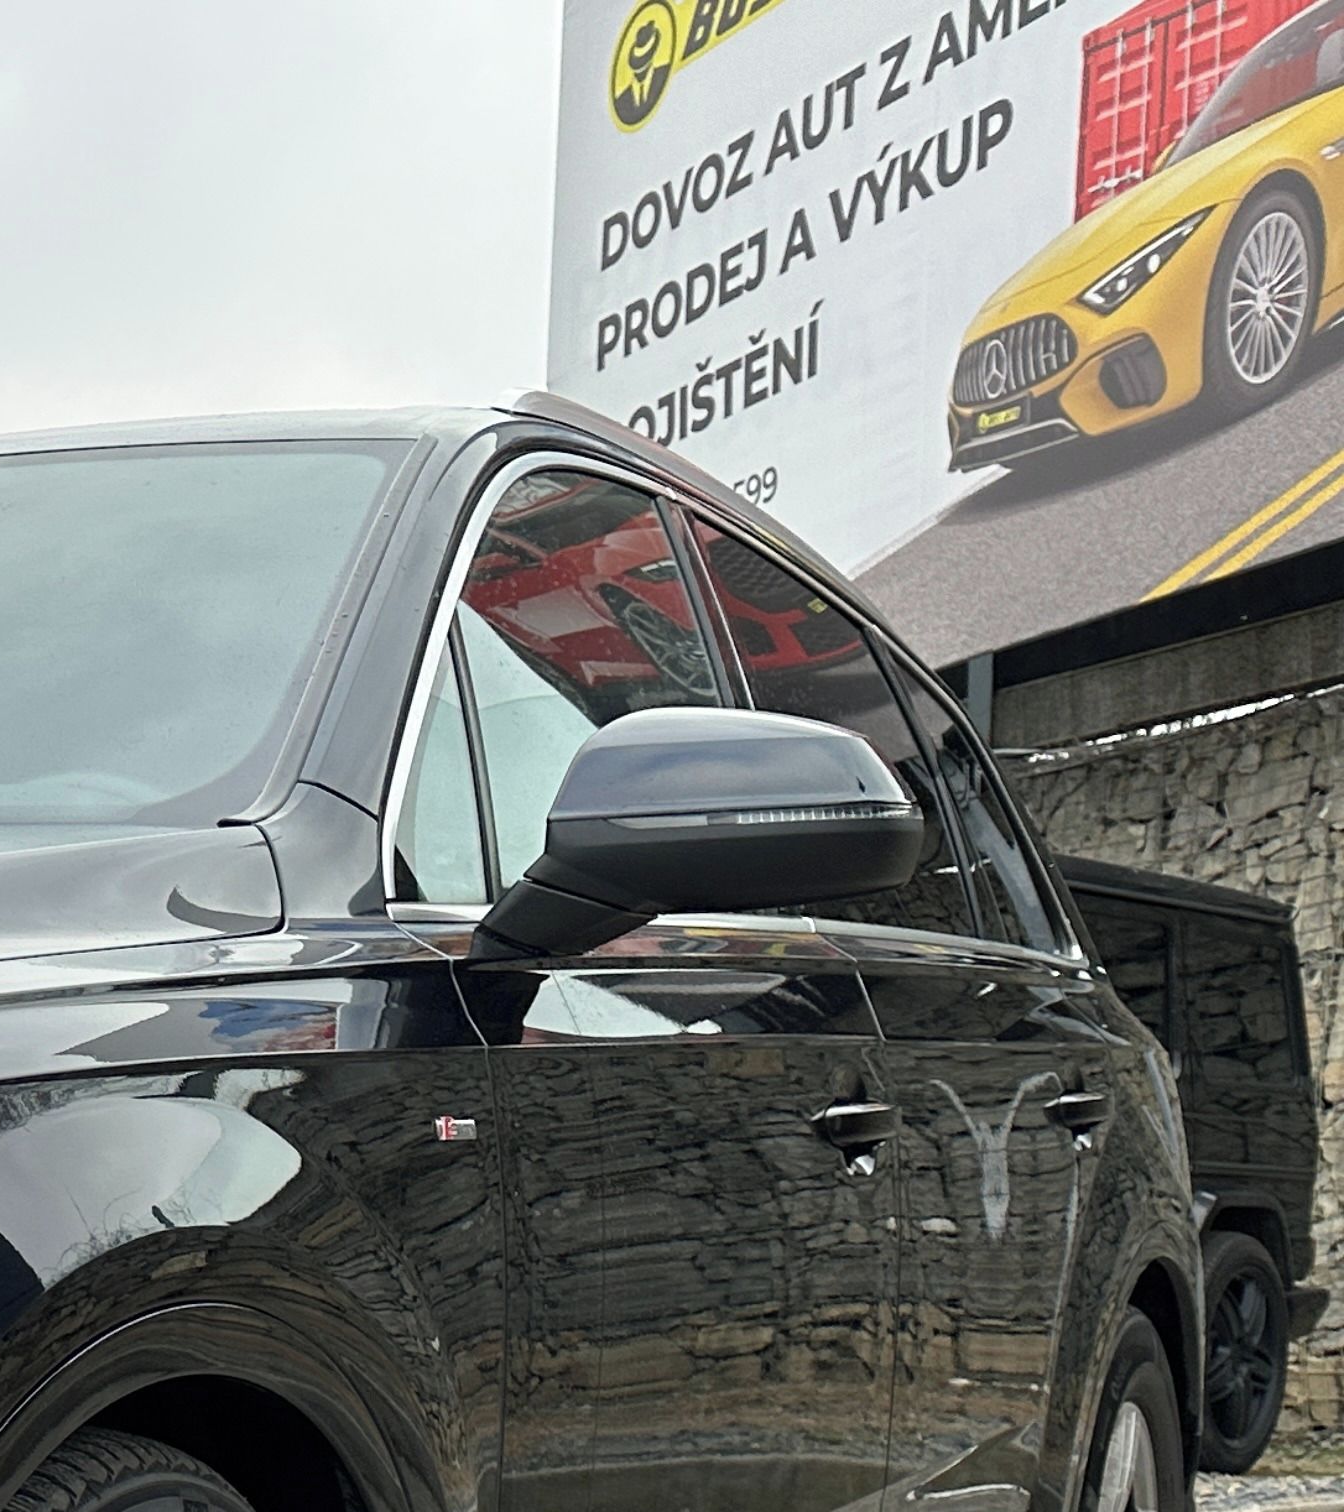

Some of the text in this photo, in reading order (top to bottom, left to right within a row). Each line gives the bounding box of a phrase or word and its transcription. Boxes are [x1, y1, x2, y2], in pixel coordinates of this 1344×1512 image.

[601, 0, 1067, 271] DOVOZ AUT Z AM
[681, 0, 773, 61] BO
[597, 99, 1013, 372] PRODEJ A VÝKUP
[628, 298, 825, 447] OJIŠTĚNÍ
